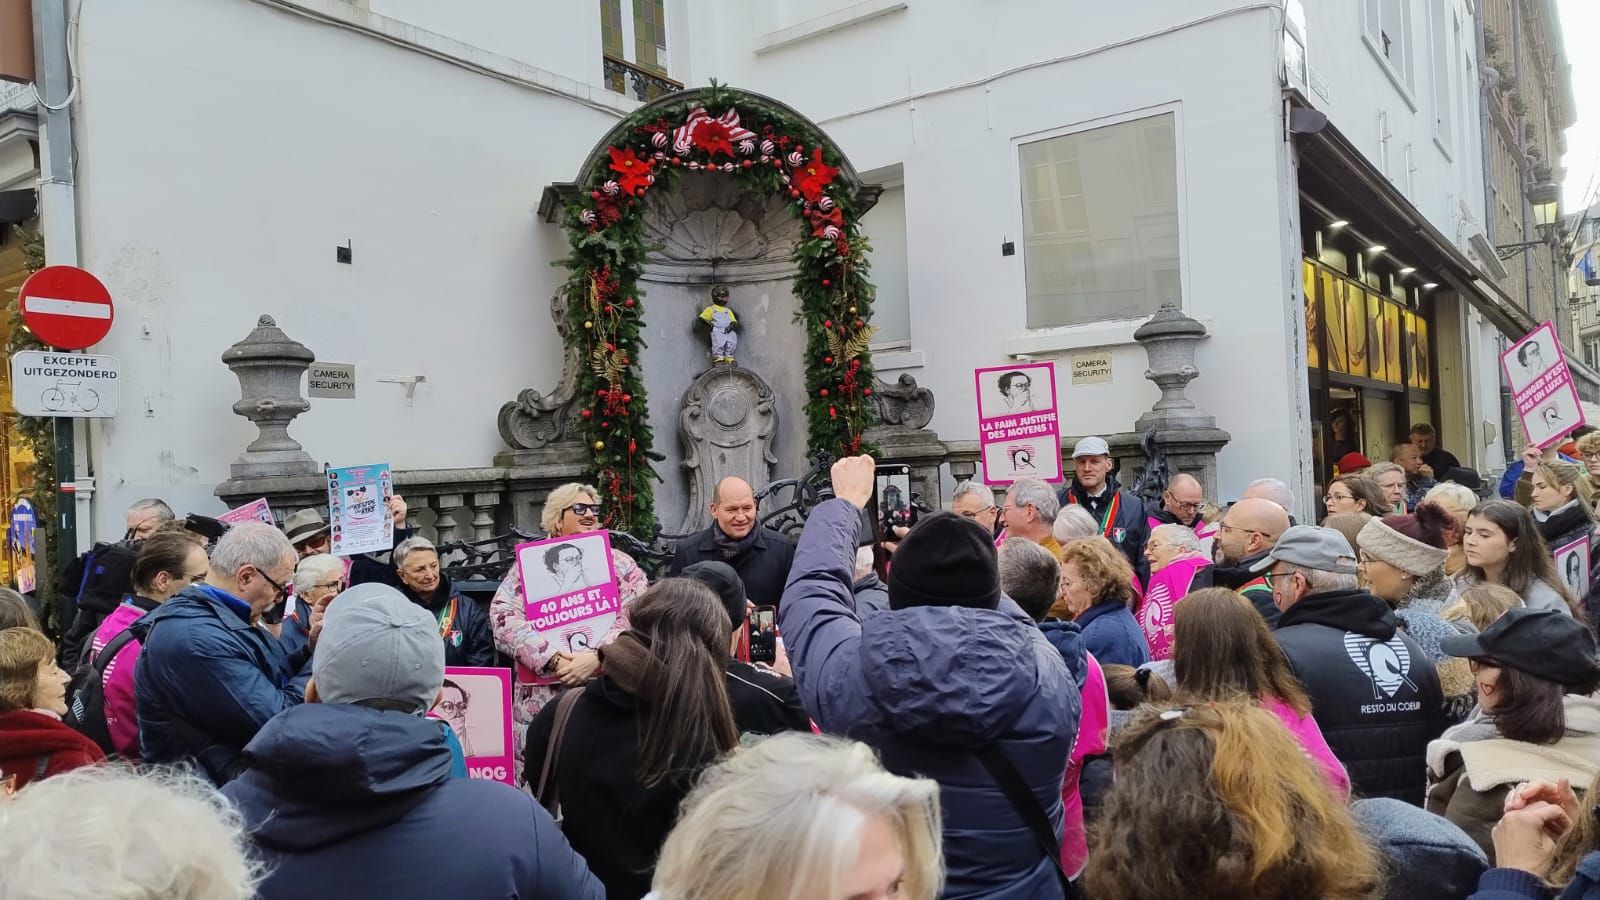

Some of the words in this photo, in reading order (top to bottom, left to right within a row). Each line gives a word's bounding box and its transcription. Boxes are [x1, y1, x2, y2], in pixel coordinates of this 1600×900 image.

[43, 356, 97, 367] EXCEPTE
[1075, 359, 1108, 369] CAMERA
[24, 367, 117, 379] UITGEZONDERD
[313, 369, 350, 379] CAMERA
[1073, 368, 1112, 378] SECURITY!
[310, 380, 354, 390] SECURITY!
[1516, 378, 1545, 406] MANGER
[1544, 361, 1565, 382] N'EST
[1520, 398, 1534, 414] PAS
[1534, 389, 1546, 402] UN
[1545, 376, 1564, 394] LUXE
[981, 422, 993, 432] LA
[994, 418, 1017, 430] FAIM
[1019, 413, 1057, 426] JUSTIFIE
[987, 430, 1006, 440] DES
[1007, 424, 1047, 438] MOYENS
[540, 601, 557, 614] 40
[560, 593, 586, 609] ANS
[587, 588, 601, 601] ET
[528, 604, 594, 629] TOUJOURS
[595, 596, 611, 612] LÀ
[1361, 703, 1385, 714] RESTO
[1386, 702, 1397, 712] DU
[469, 765, 507, 780] NOG
